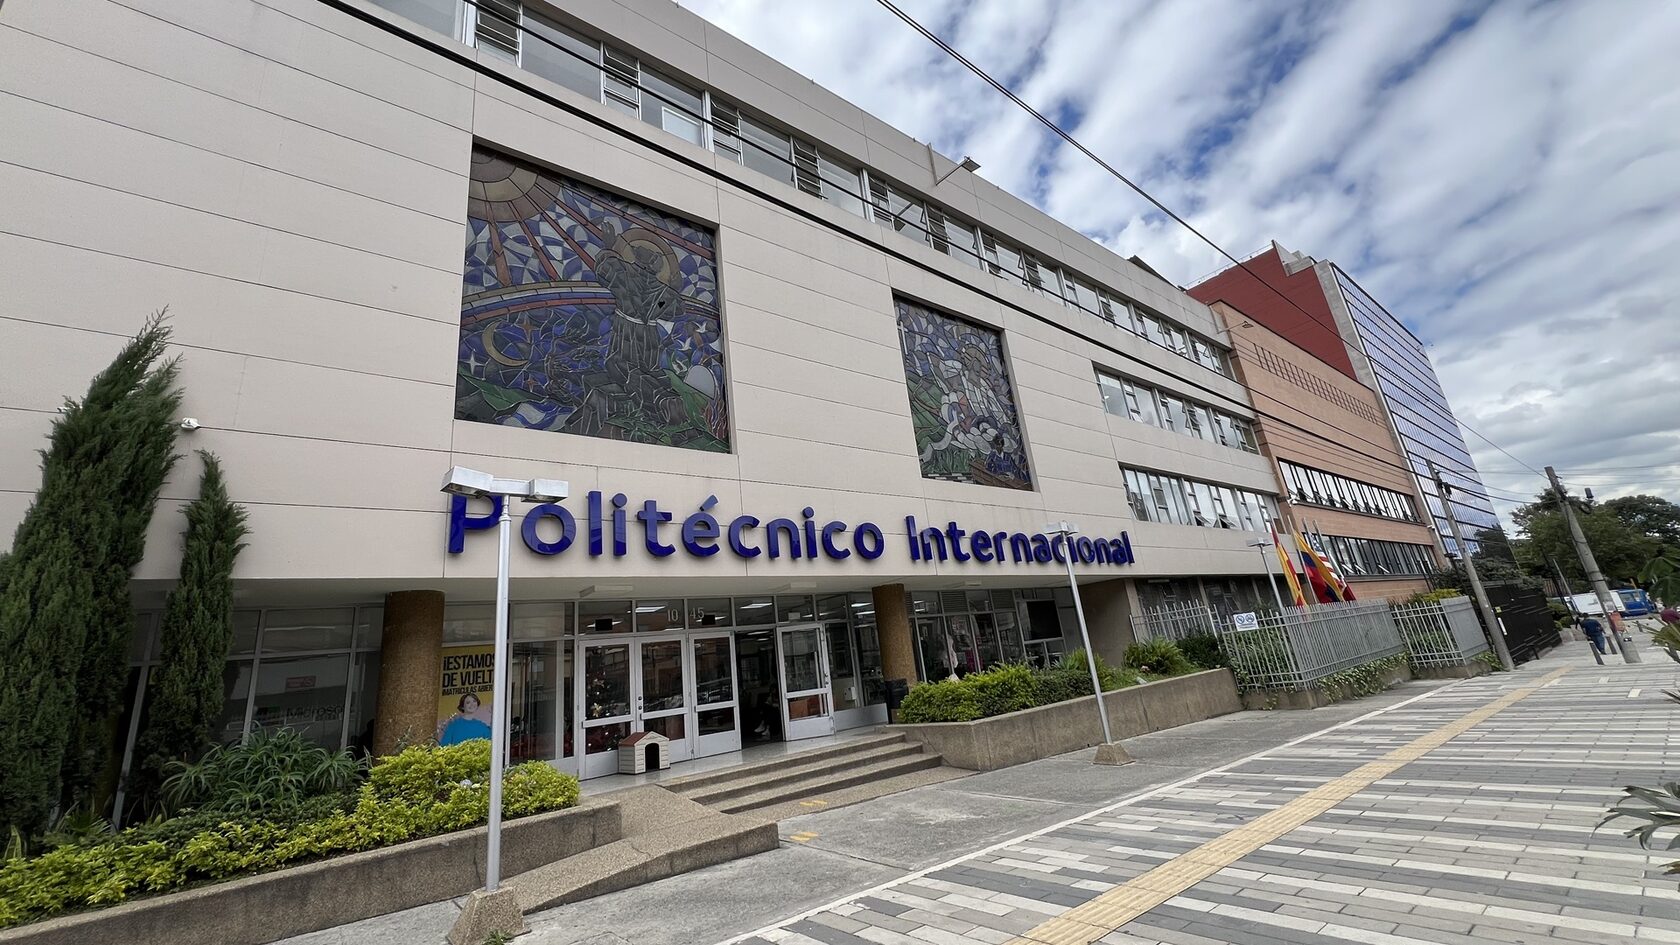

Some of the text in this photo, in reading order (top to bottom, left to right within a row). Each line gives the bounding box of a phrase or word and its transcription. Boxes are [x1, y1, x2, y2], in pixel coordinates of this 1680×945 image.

[448, 490, 1135, 565] Politécnico Internacional
[667, 607, 704, 622] 10 45
[442, 669, 495, 688] DE VUELT
